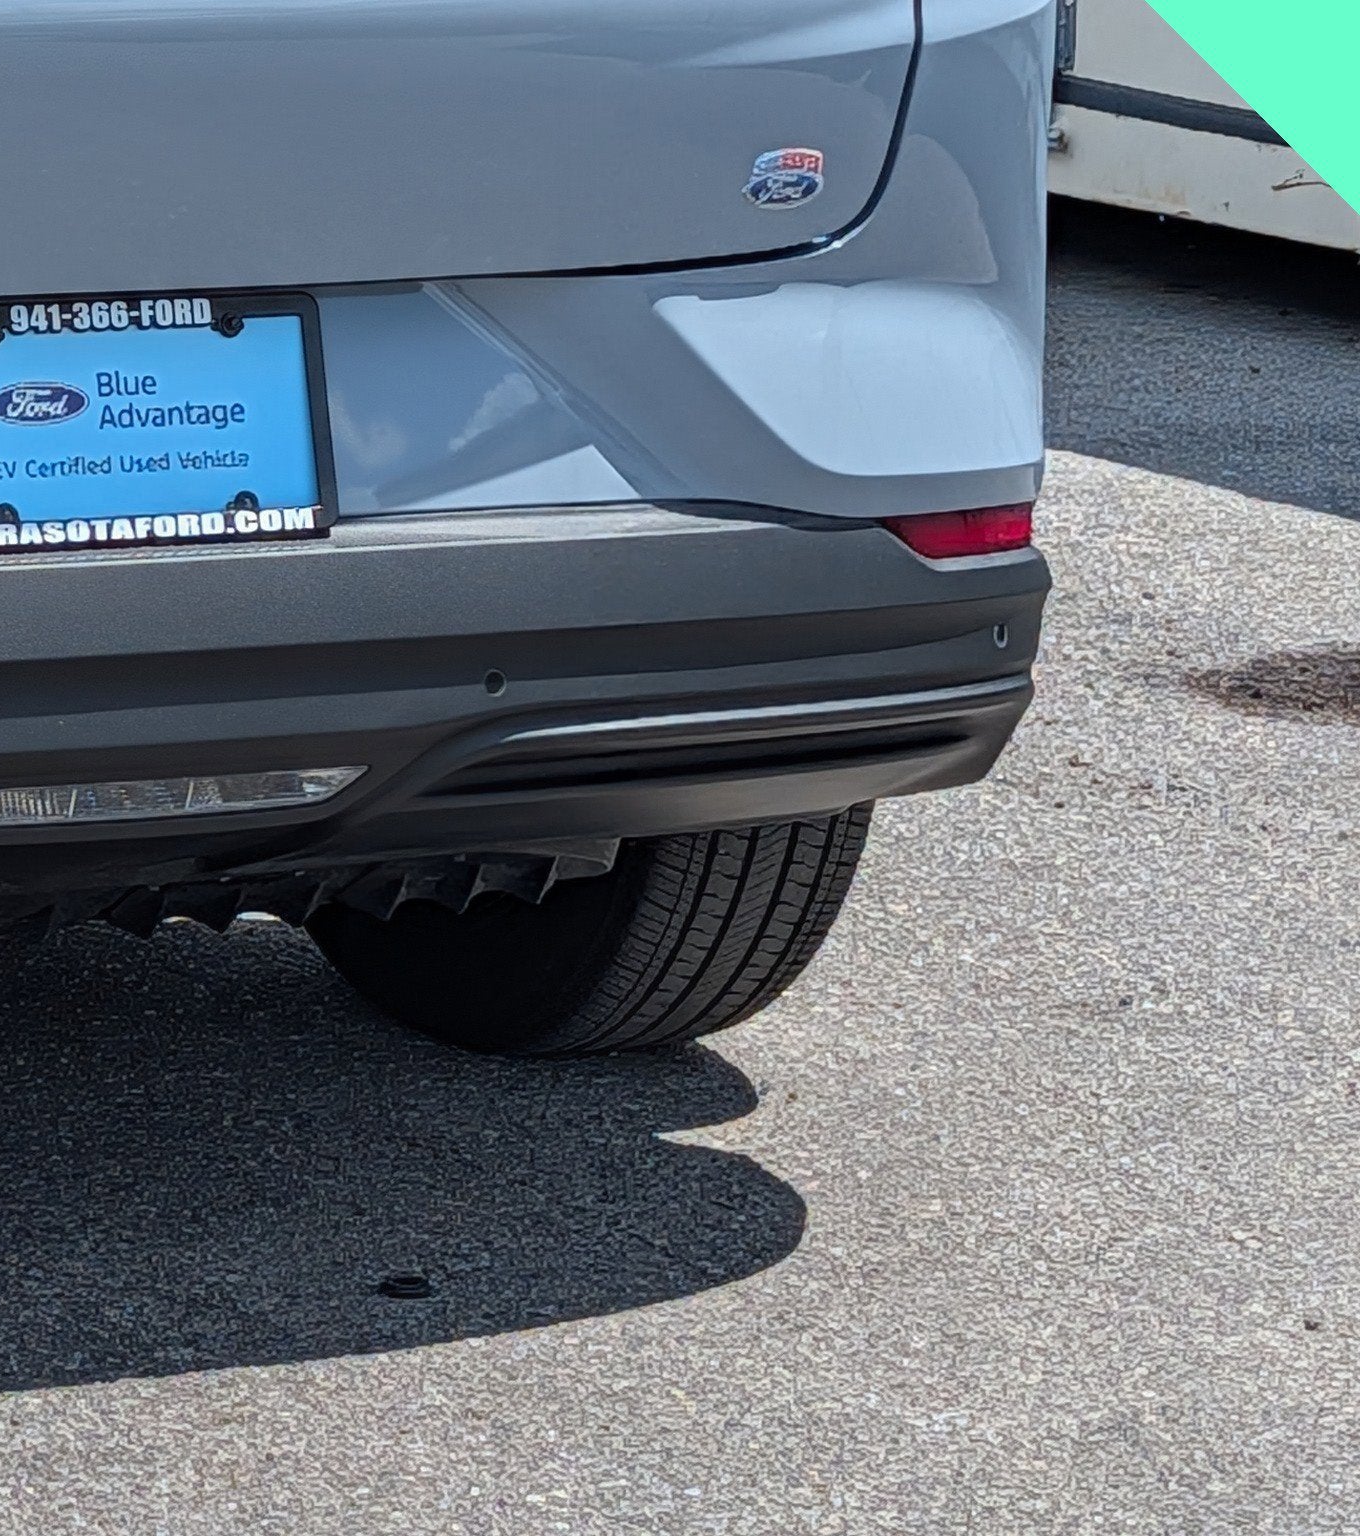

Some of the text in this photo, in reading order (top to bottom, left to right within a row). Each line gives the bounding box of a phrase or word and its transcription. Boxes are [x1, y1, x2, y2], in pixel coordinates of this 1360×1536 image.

[9, 298, 212, 332] 941-366-FORD
[96, 371, 157, 397] Blue
[5, 387, 69, 418] Ford
[99, 401, 246, 430] Advantage
[25, 454, 112, 479] Certified
[119, 451, 170, 474] Used
